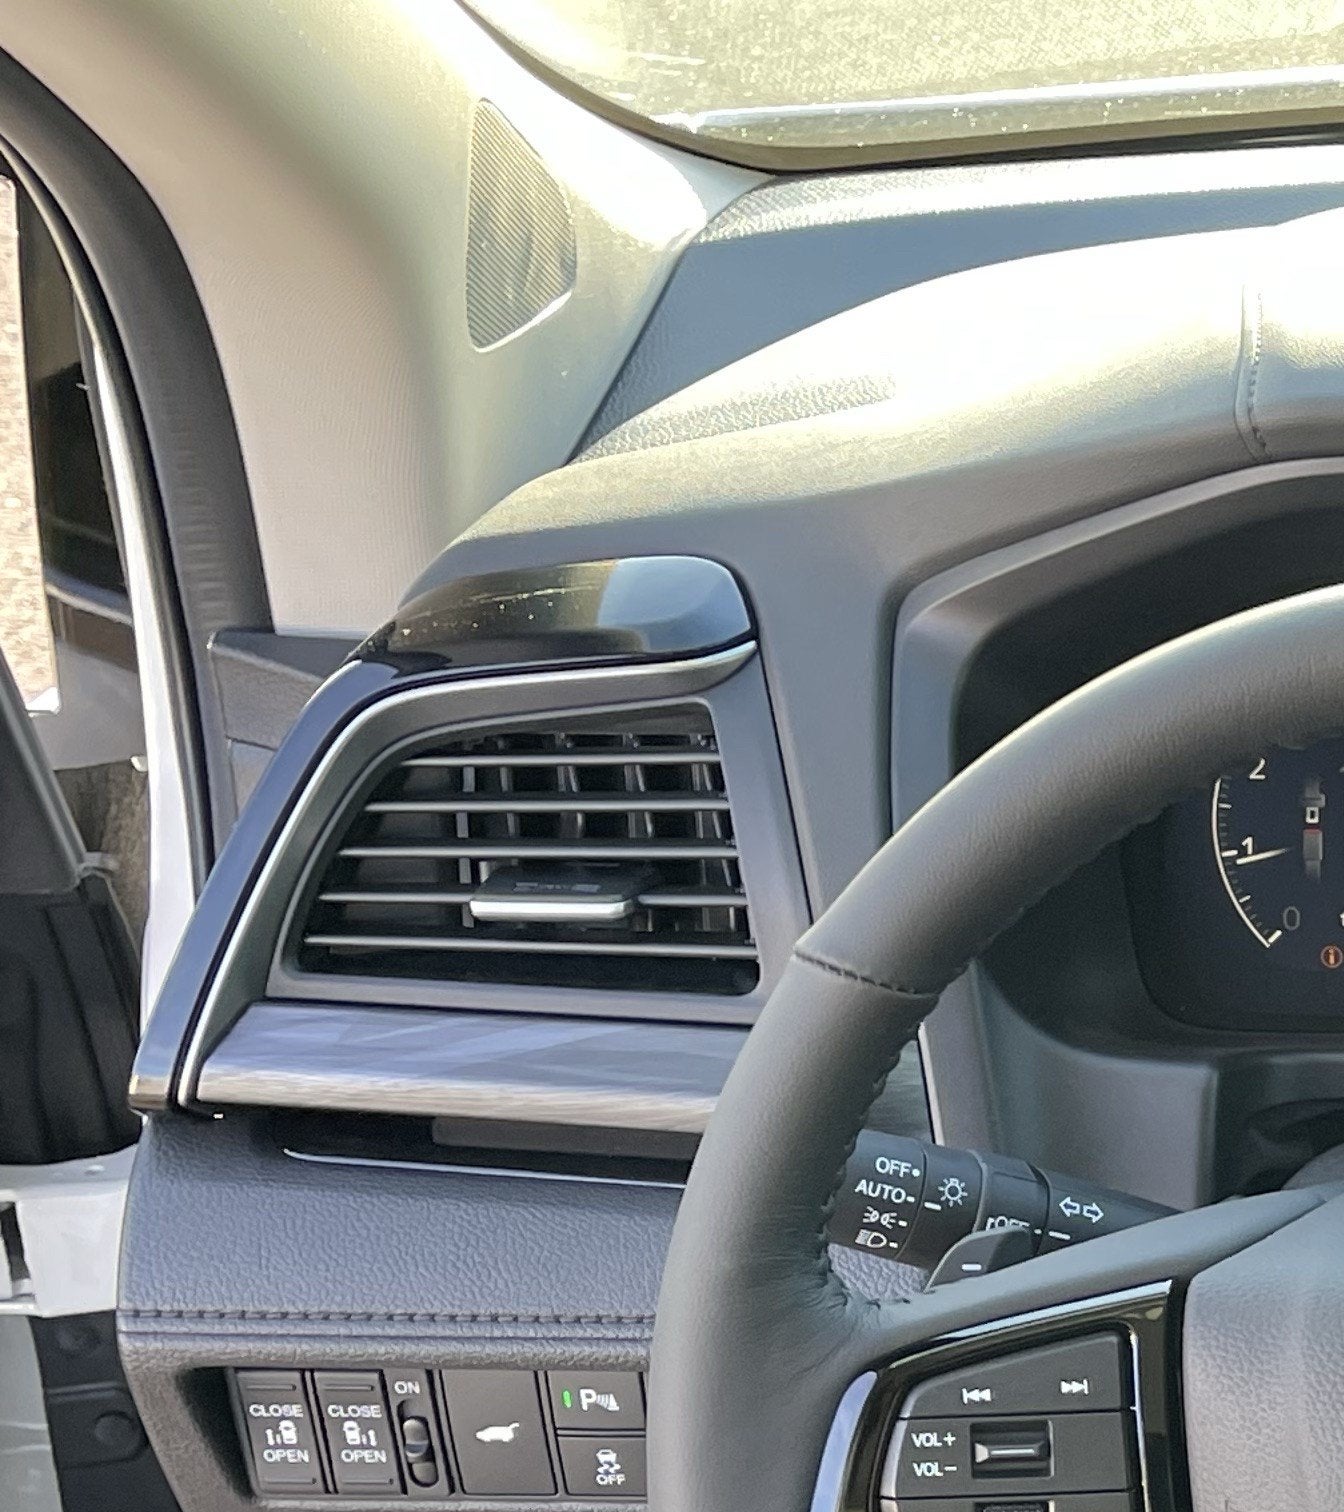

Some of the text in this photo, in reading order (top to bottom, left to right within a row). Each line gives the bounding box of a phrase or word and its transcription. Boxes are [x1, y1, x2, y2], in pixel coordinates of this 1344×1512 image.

[1241, 836, 1254, 855] 1
[1282, 905, 1301, 931] 0
[875, 1156, 912, 1178] OFF
[855, 1178, 907, 1204] AUTO
[394, 1380, 421, 1395] ON
[248, 1403, 304, 1419] CLOSE
[327, 1404, 383, 1419] CLOSE
[263, 1449, 309, 1464] OPEN
[341, 1449, 387, 1464] OPEN
[595, 1473, 626, 1486] OFF
